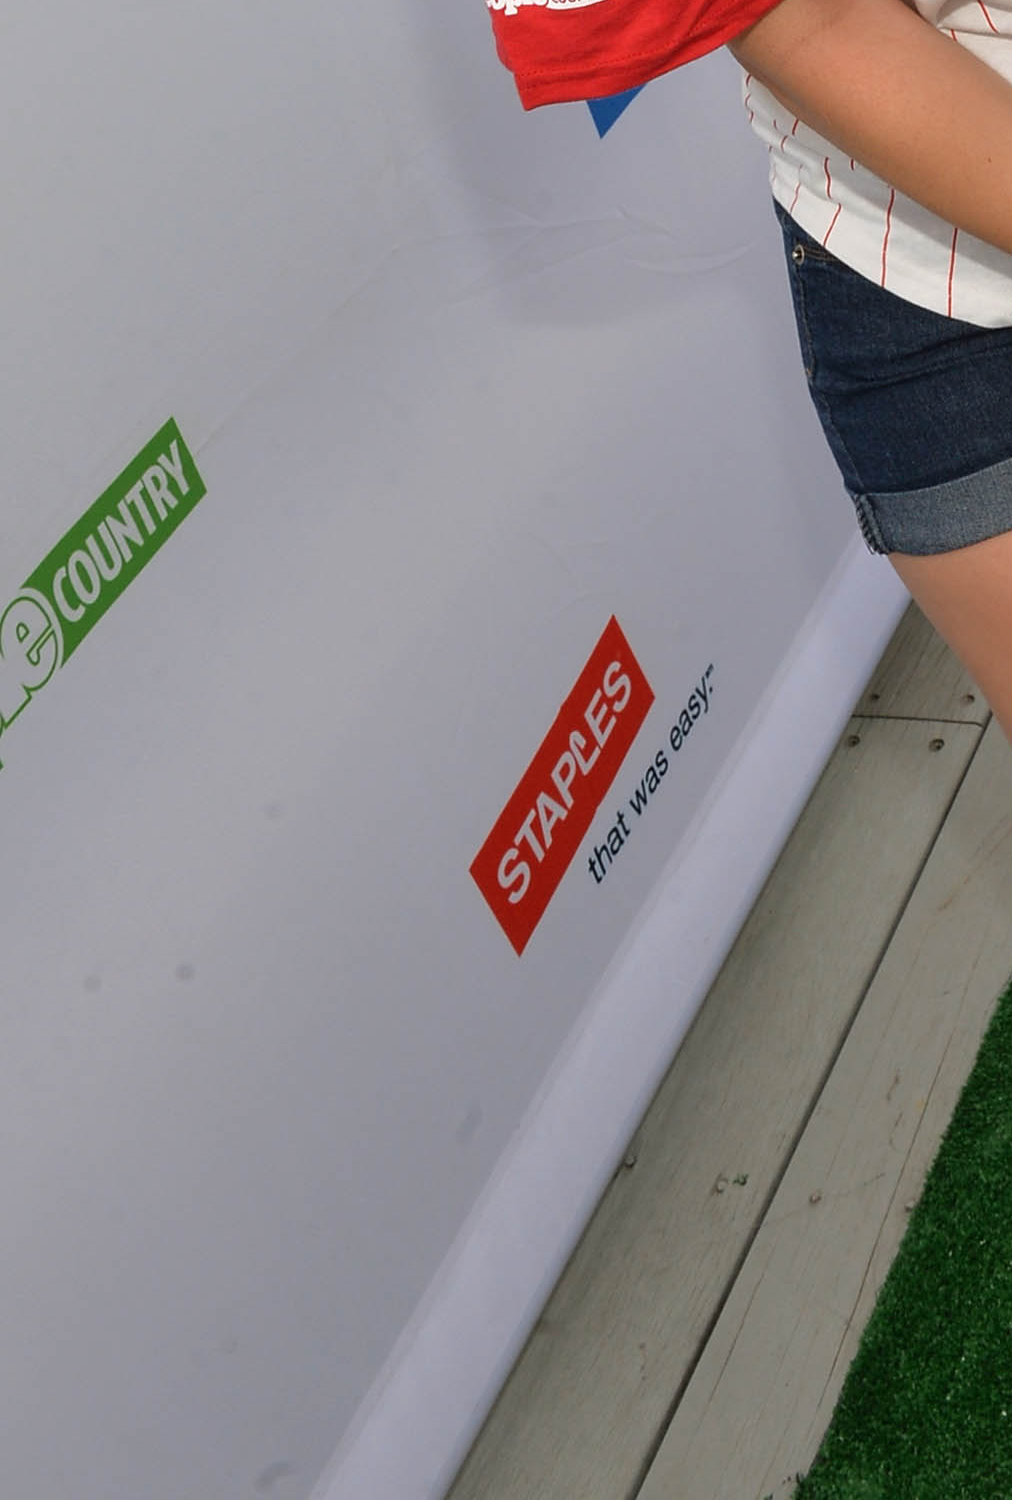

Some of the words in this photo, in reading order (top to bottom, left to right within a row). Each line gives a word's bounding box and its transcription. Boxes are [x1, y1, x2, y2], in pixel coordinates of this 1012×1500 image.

[52, 439, 191, 623] COUNTRY
[497, 660, 632, 904] STAPLES
[587, 810, 632, 885] that
[629, 750, 670, 816] was
